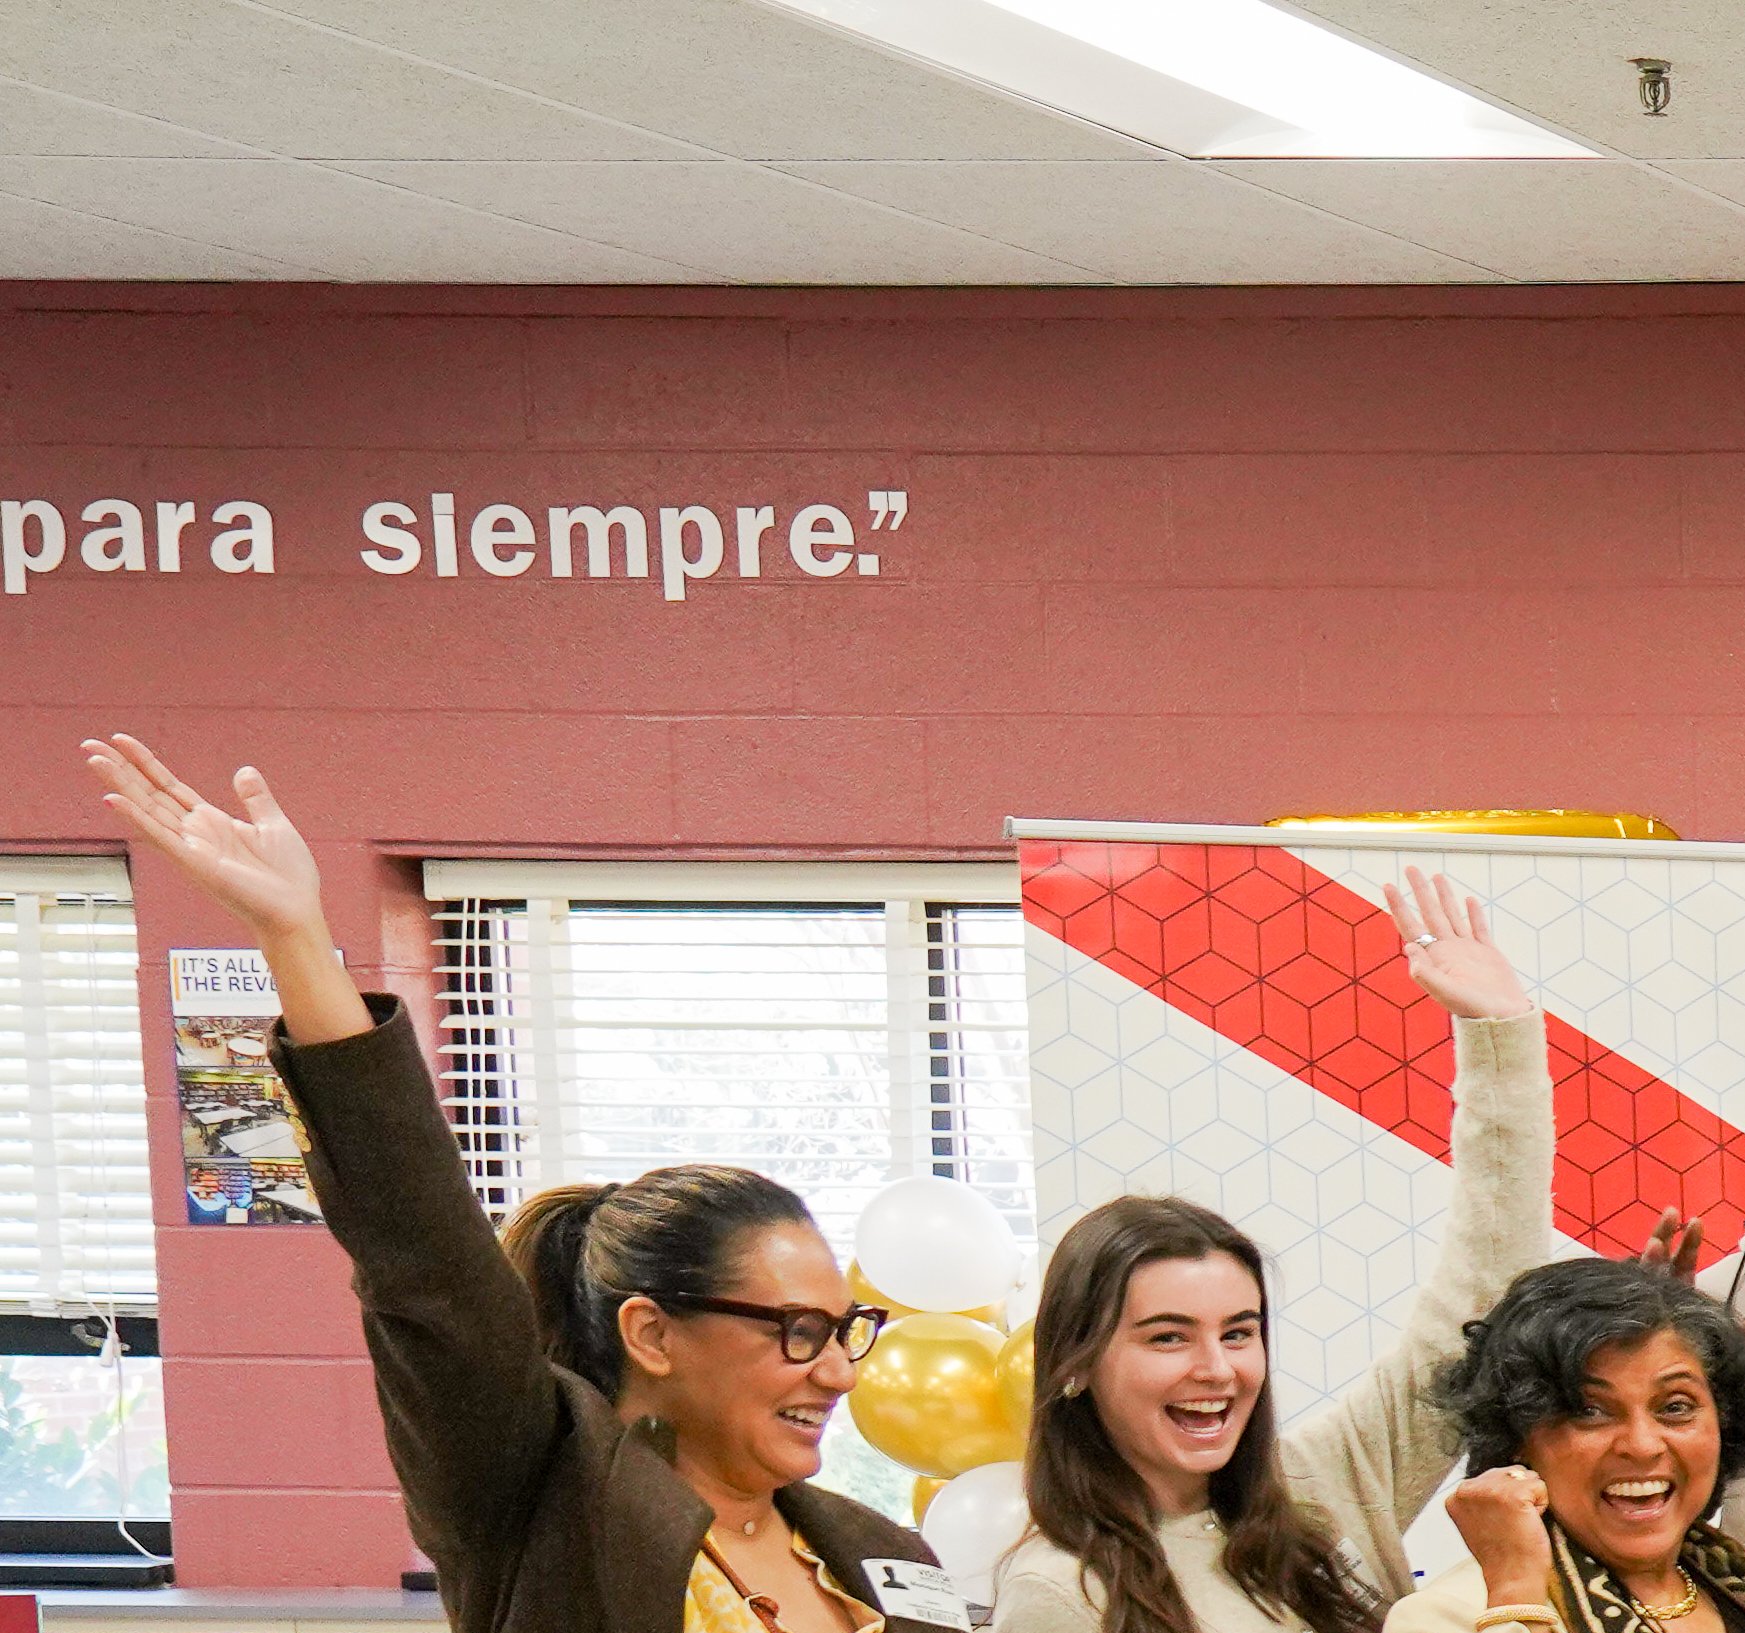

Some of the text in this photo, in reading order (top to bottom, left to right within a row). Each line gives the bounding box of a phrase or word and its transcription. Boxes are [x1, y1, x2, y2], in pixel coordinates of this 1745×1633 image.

[2, 498, 277, 595] para
[182, 958, 219, 973] IT’S
[224, 958, 261, 973] ALL
[181, 976, 222, 991] THE
